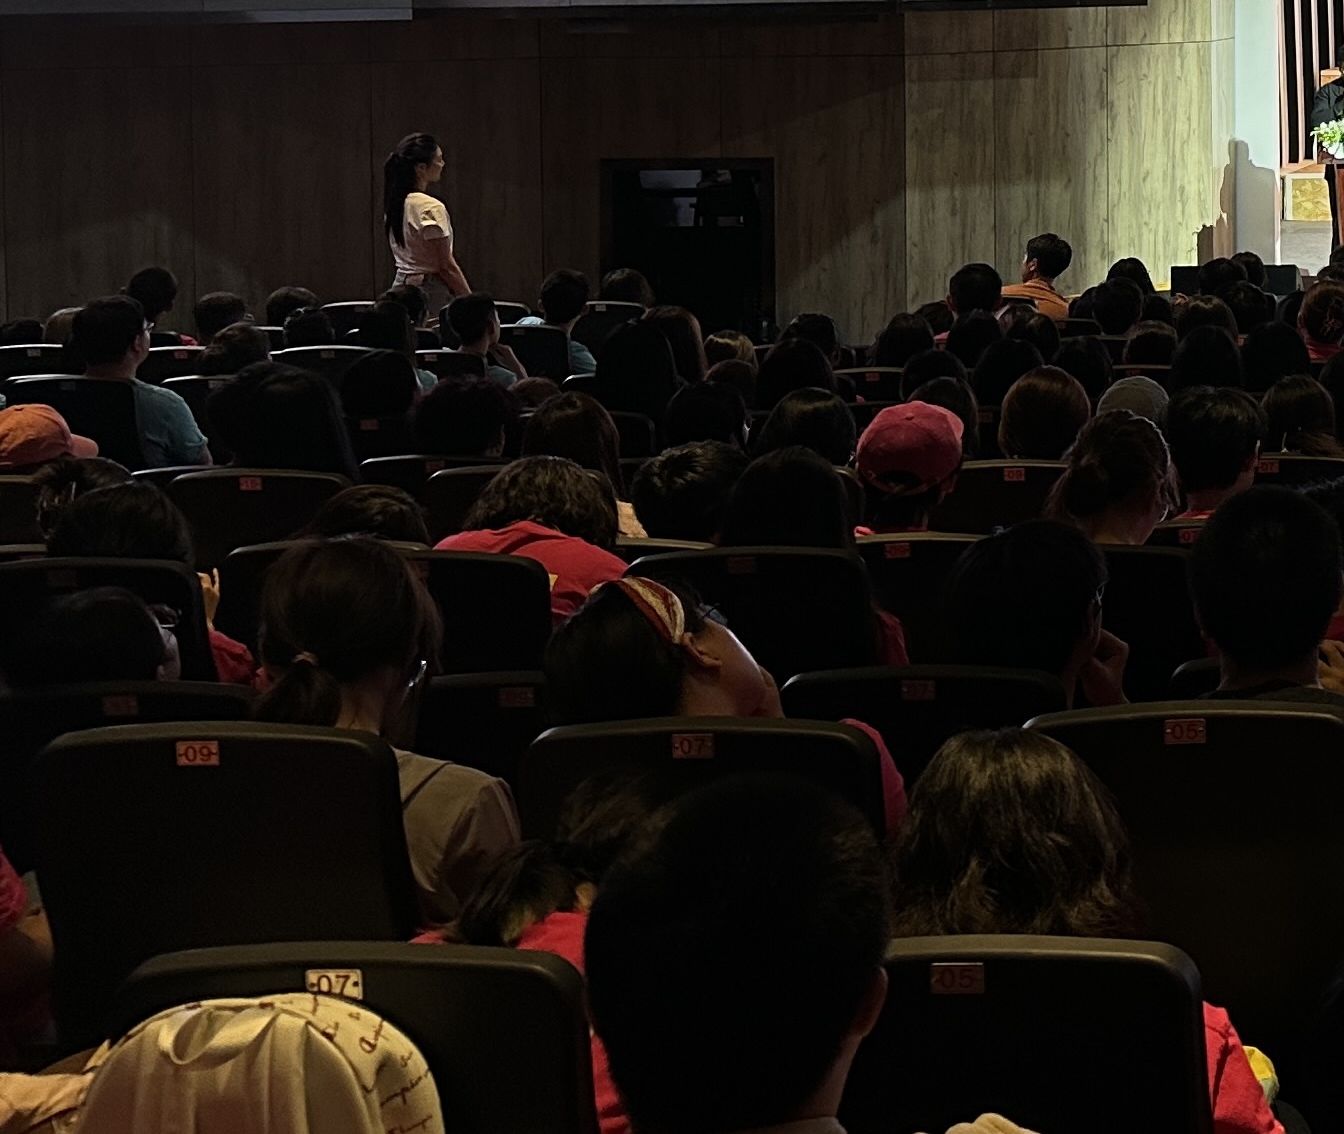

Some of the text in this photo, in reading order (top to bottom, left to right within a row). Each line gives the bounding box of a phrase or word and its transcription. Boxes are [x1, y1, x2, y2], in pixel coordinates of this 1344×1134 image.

[1171, 723, 1199, 740] 05
[184, 745, 211, 762] 09
[679, 737, 706, 755] 07
[316, 974, 351, 995] 07
[940, 967, 974, 989] 05
